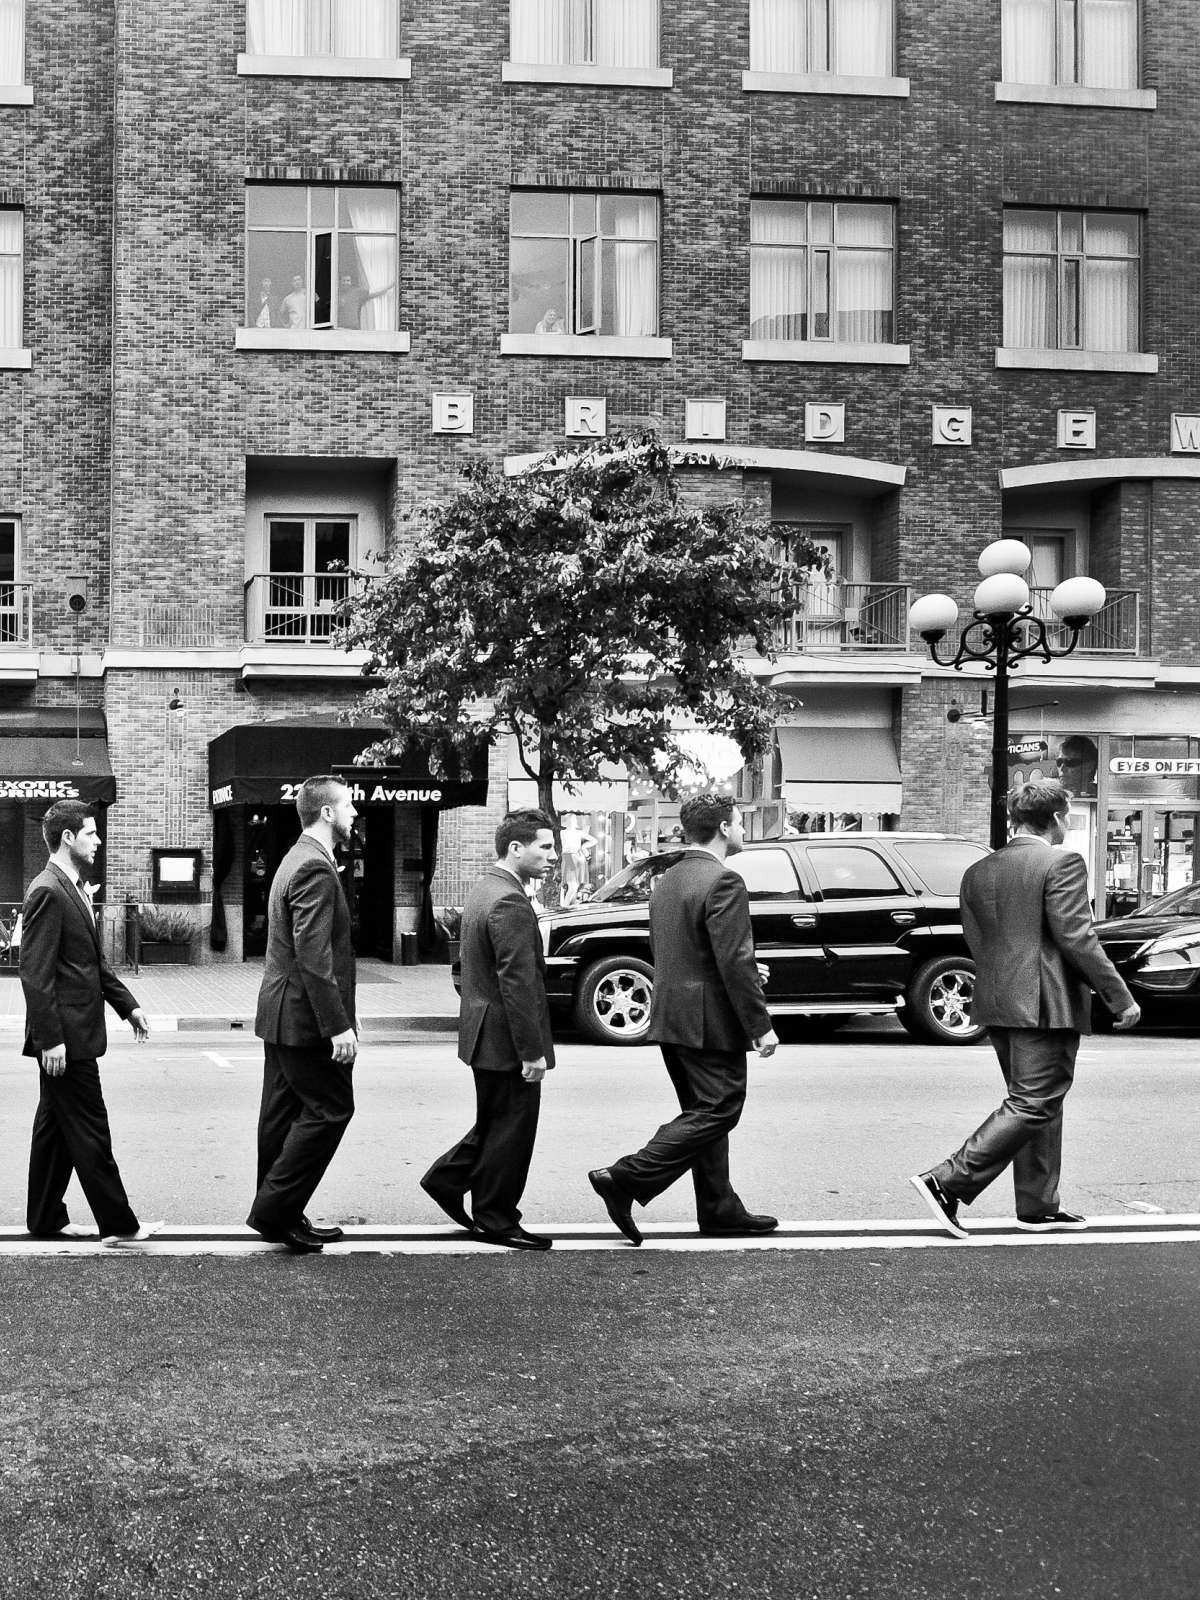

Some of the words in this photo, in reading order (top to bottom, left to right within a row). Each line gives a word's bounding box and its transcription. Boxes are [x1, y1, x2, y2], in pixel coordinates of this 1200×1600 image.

[1008, 743, 1040, 753] TICIANS
[1118, 762, 1150, 771] EYES
[1155, 762, 1172, 771] ON
[371, 785, 442, 801] Avenue
